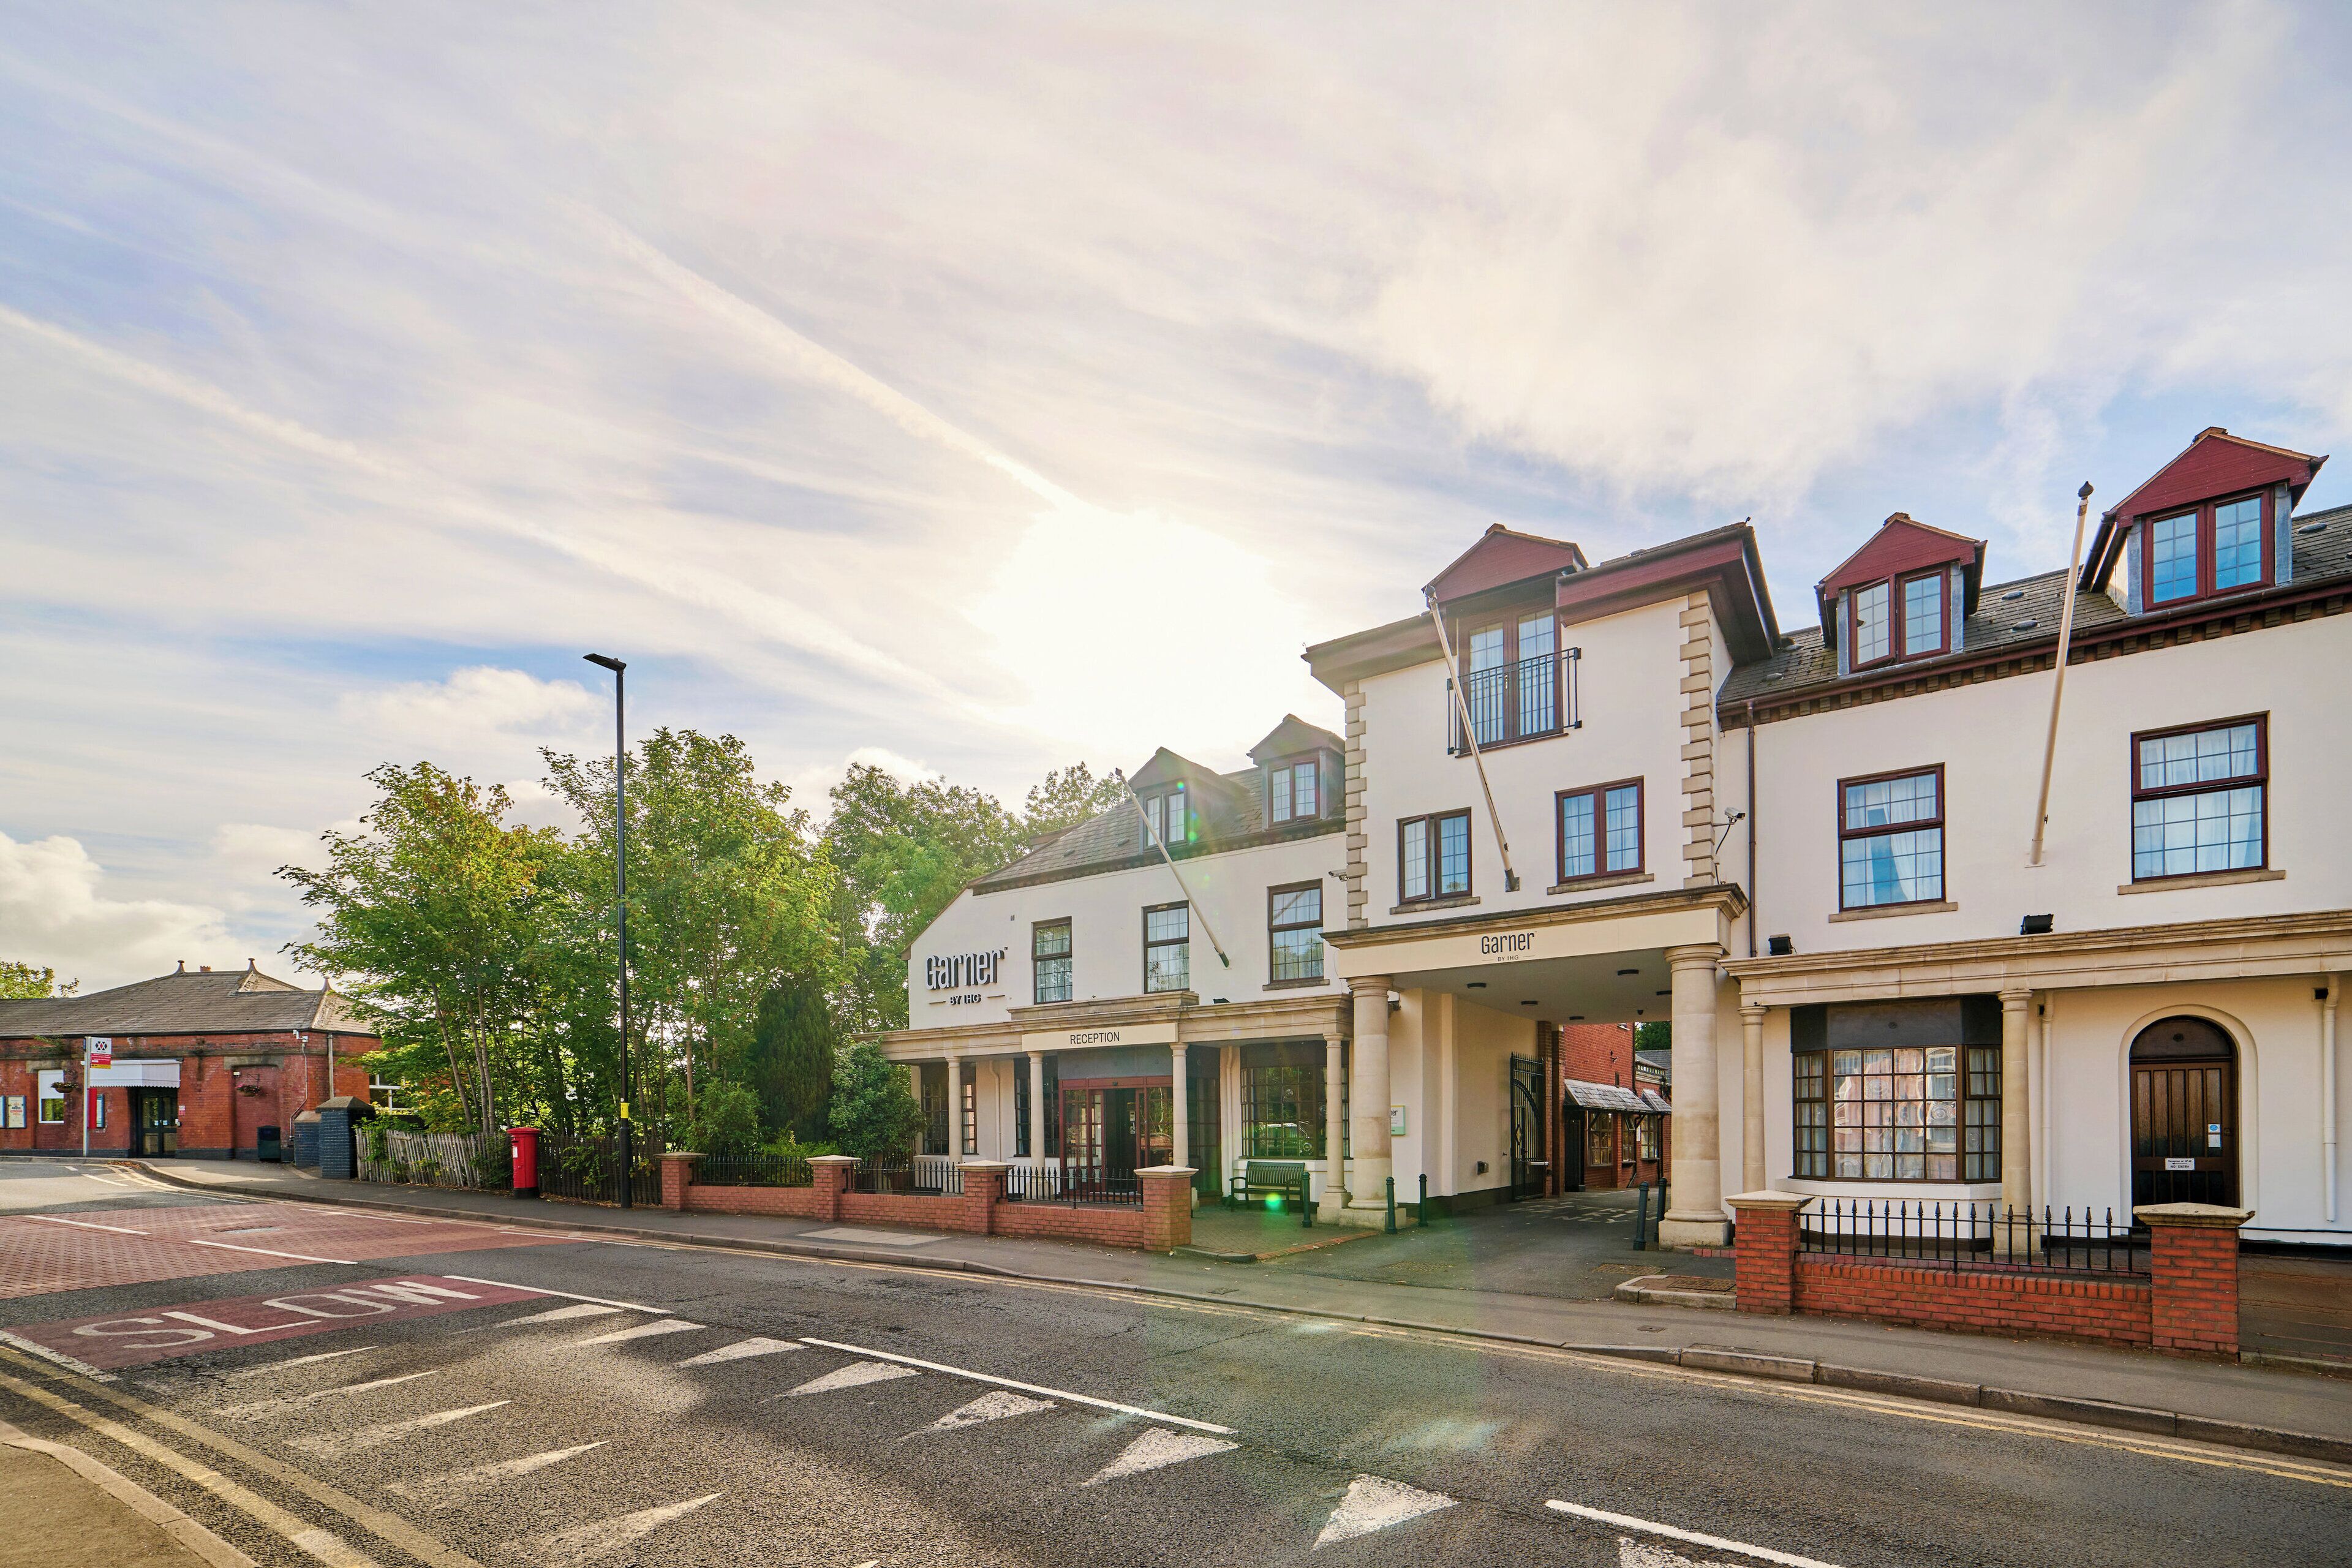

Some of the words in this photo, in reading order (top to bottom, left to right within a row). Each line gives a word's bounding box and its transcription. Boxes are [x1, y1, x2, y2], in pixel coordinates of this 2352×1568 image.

[1481, 932, 1535, 954] Garner
[925, 949, 1005, 990] Garner
[950, 995, 962, 1005] BY
[963, 993, 982, 1004] IHG
[1070, 1031, 1120, 1044] RECEPTION
[72, 1280, 484, 1349] SLOW
